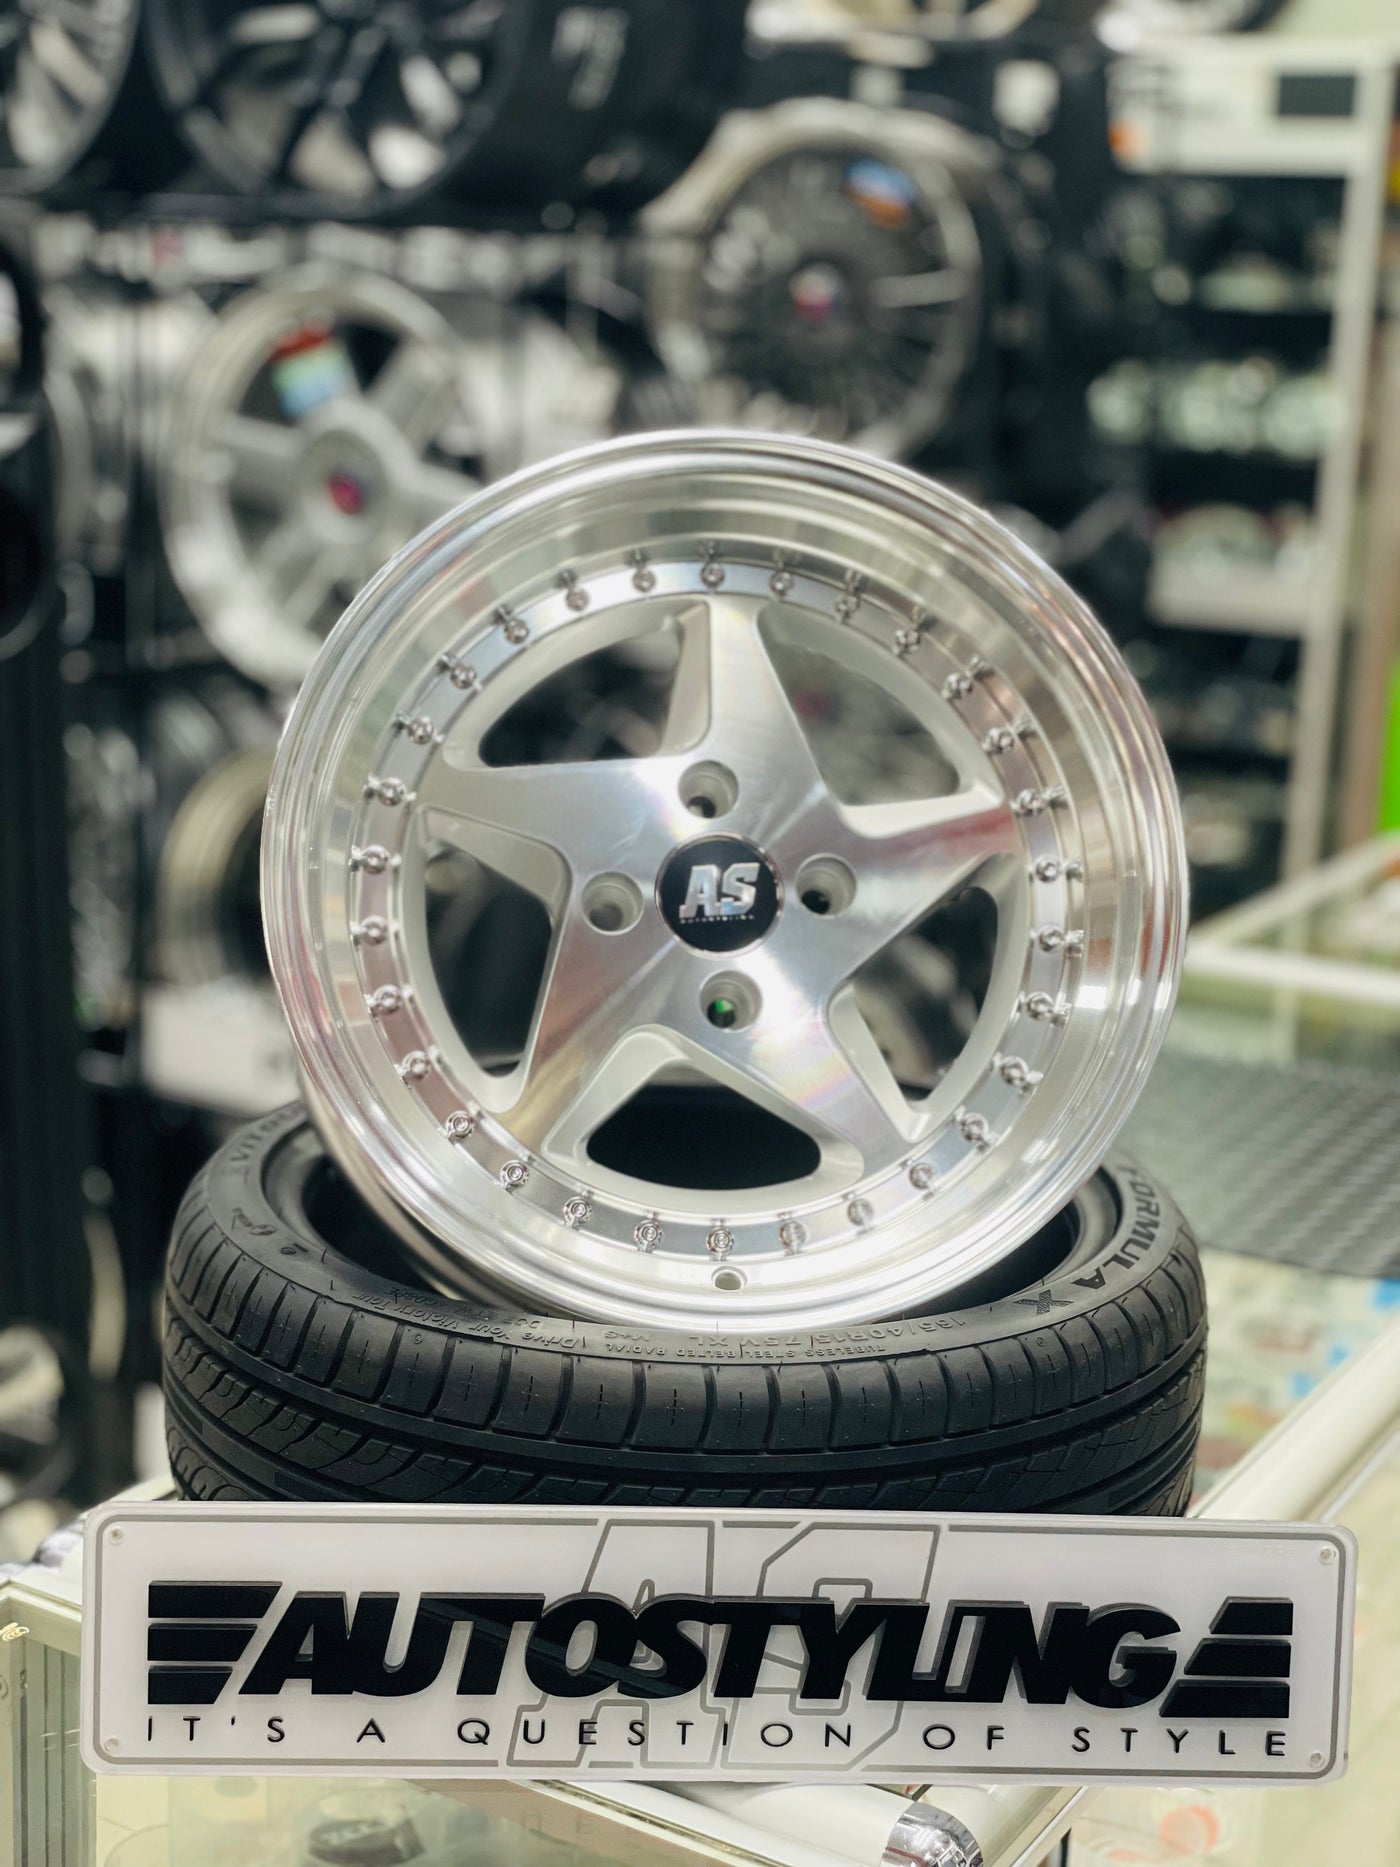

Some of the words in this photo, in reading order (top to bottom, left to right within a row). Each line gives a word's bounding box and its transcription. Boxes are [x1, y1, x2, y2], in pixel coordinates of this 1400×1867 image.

[679, 862, 760, 919] AS
[1070, 1165, 1160, 1289] FORMULA
[1012, 1289, 1074, 1316] X
[394, 1304, 460, 1329] Victory
[522, 1333, 578, 1349] Drive
[605, 1343, 666, 1357] RADIAL
[689, 1334, 728, 1346] XL
[676, 1348, 736, 1359] BELTED
[745, 1348, 796, 1359] STEEL
[805, 1344, 887, 1357] TUBELESS
[238, 1590, 1181, 1709] AUTOSTYLING
[147, 1714, 287, 1744] IT'S
[356, 1717, 386, 1744] A
[456, 1717, 852, 1749] QUESTION
[922, 1723, 1005, 1751] OF
[1071, 1726, 1287, 1757] STYLE
